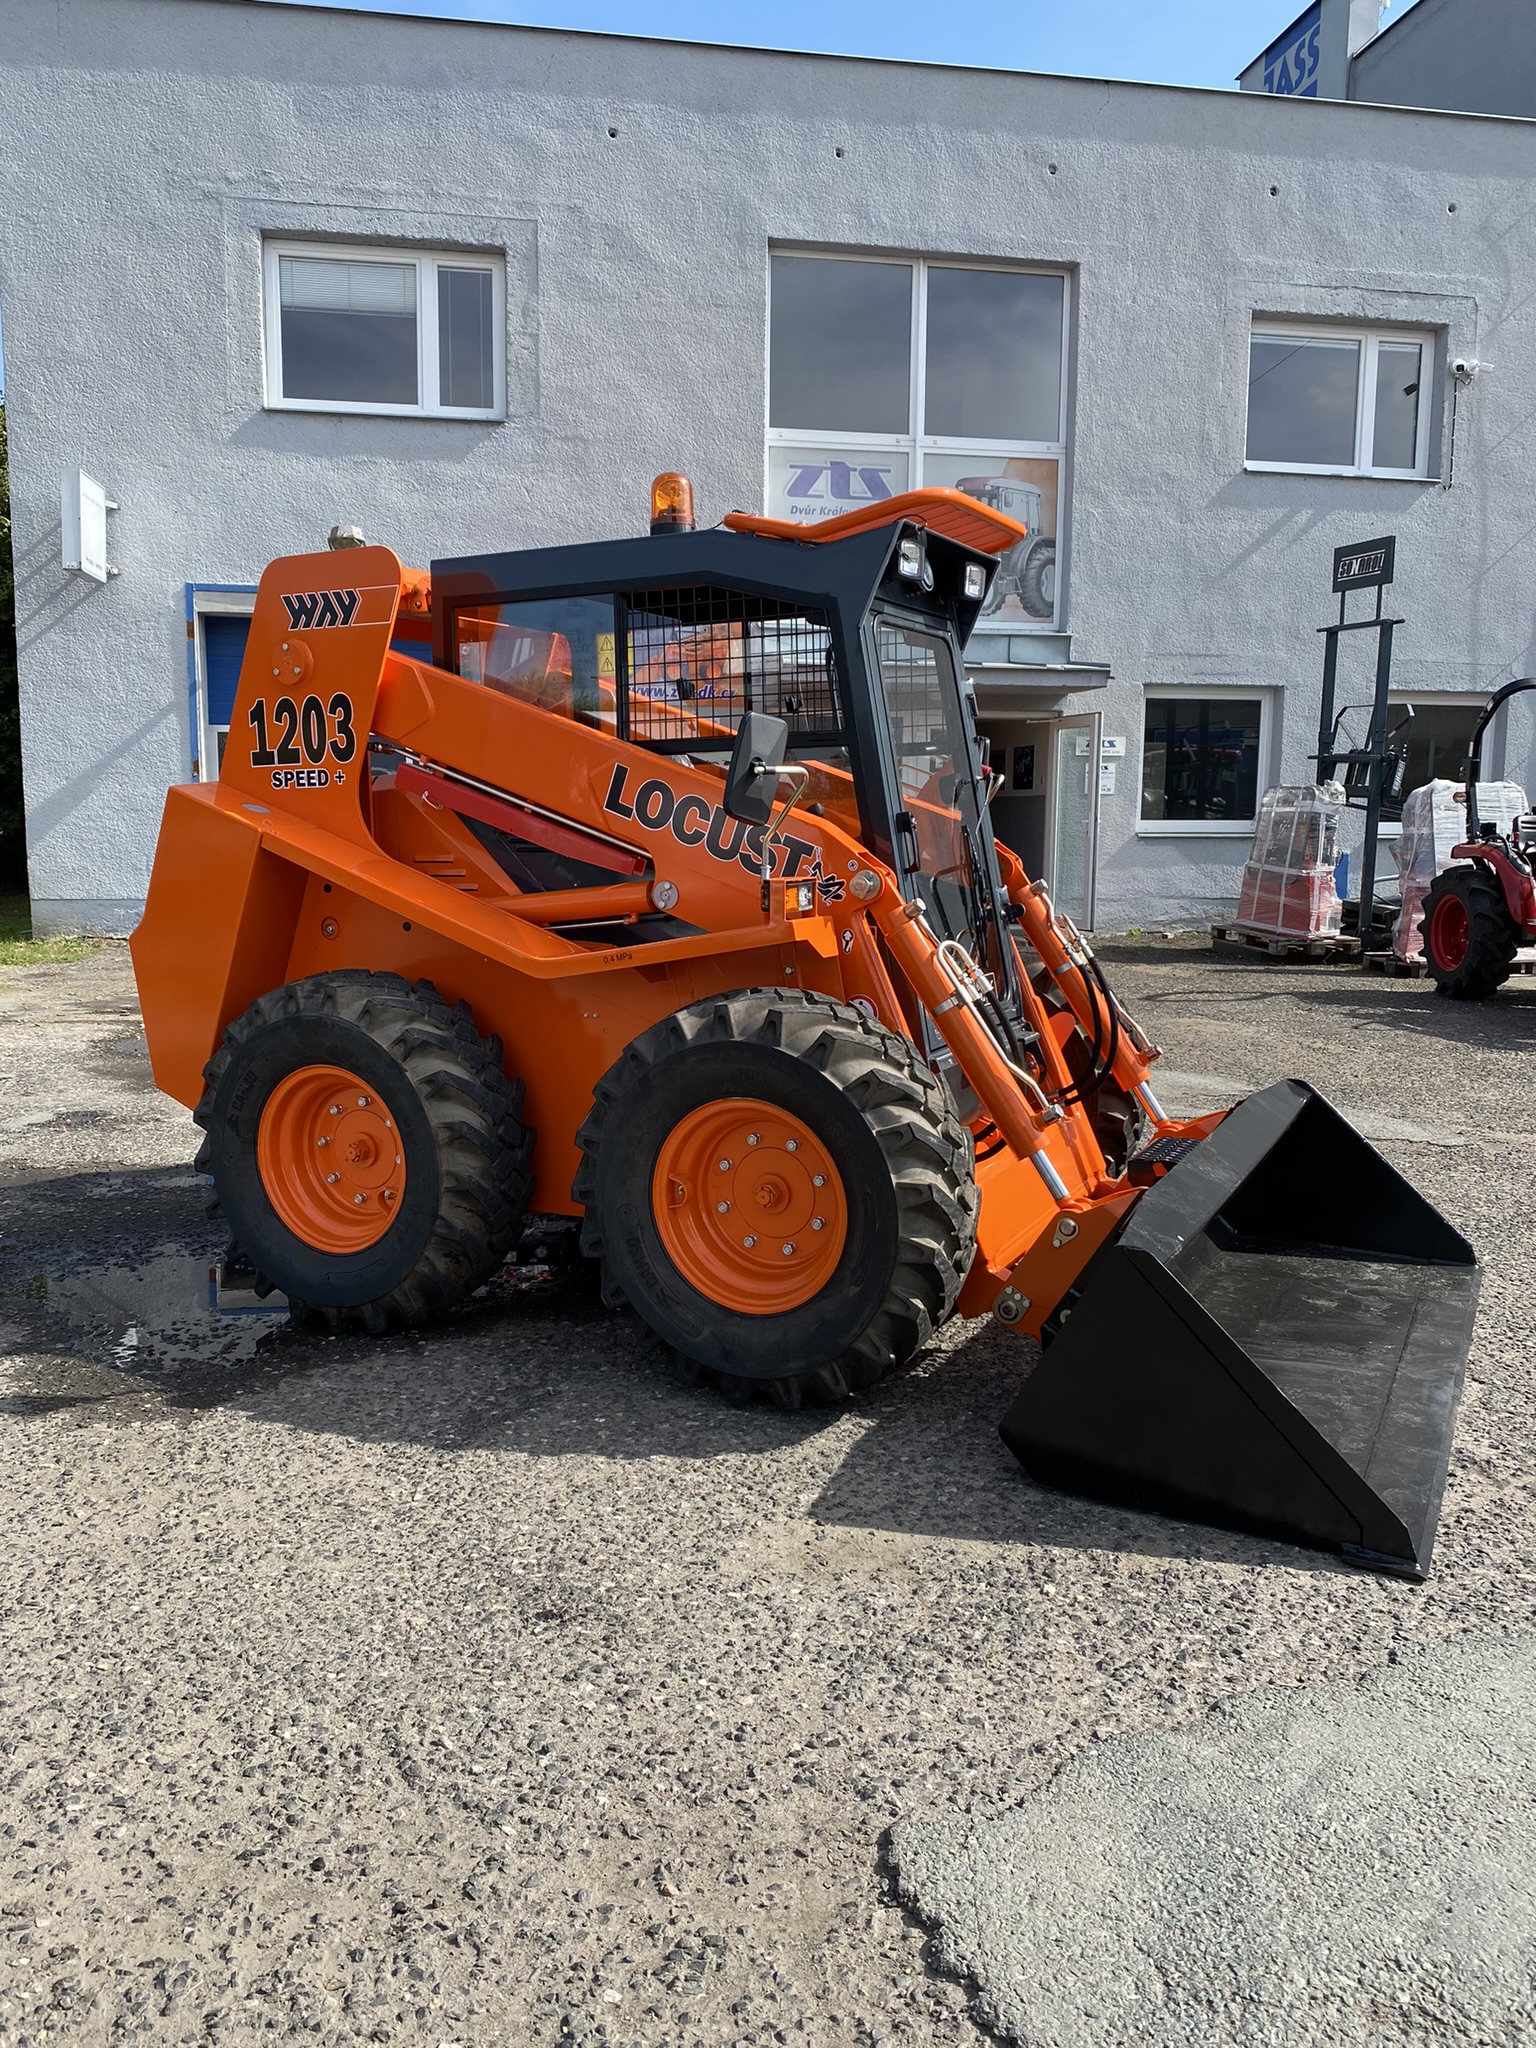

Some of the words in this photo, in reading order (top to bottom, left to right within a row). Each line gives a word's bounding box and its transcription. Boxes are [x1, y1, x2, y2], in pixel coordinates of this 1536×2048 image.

[786, 460, 893, 501] zts
[790, 504, 817, 515] Dvůr
[819, 506, 852, 516] Králo
[280, 588, 362, 631] WAY
[248, 691, 357, 767] 1203
[271, 769, 330, 789] SPEED
[334, 770, 346, 785] +
[603, 762, 816, 878] LOCUST
[616, 952, 632, 961] MPa
